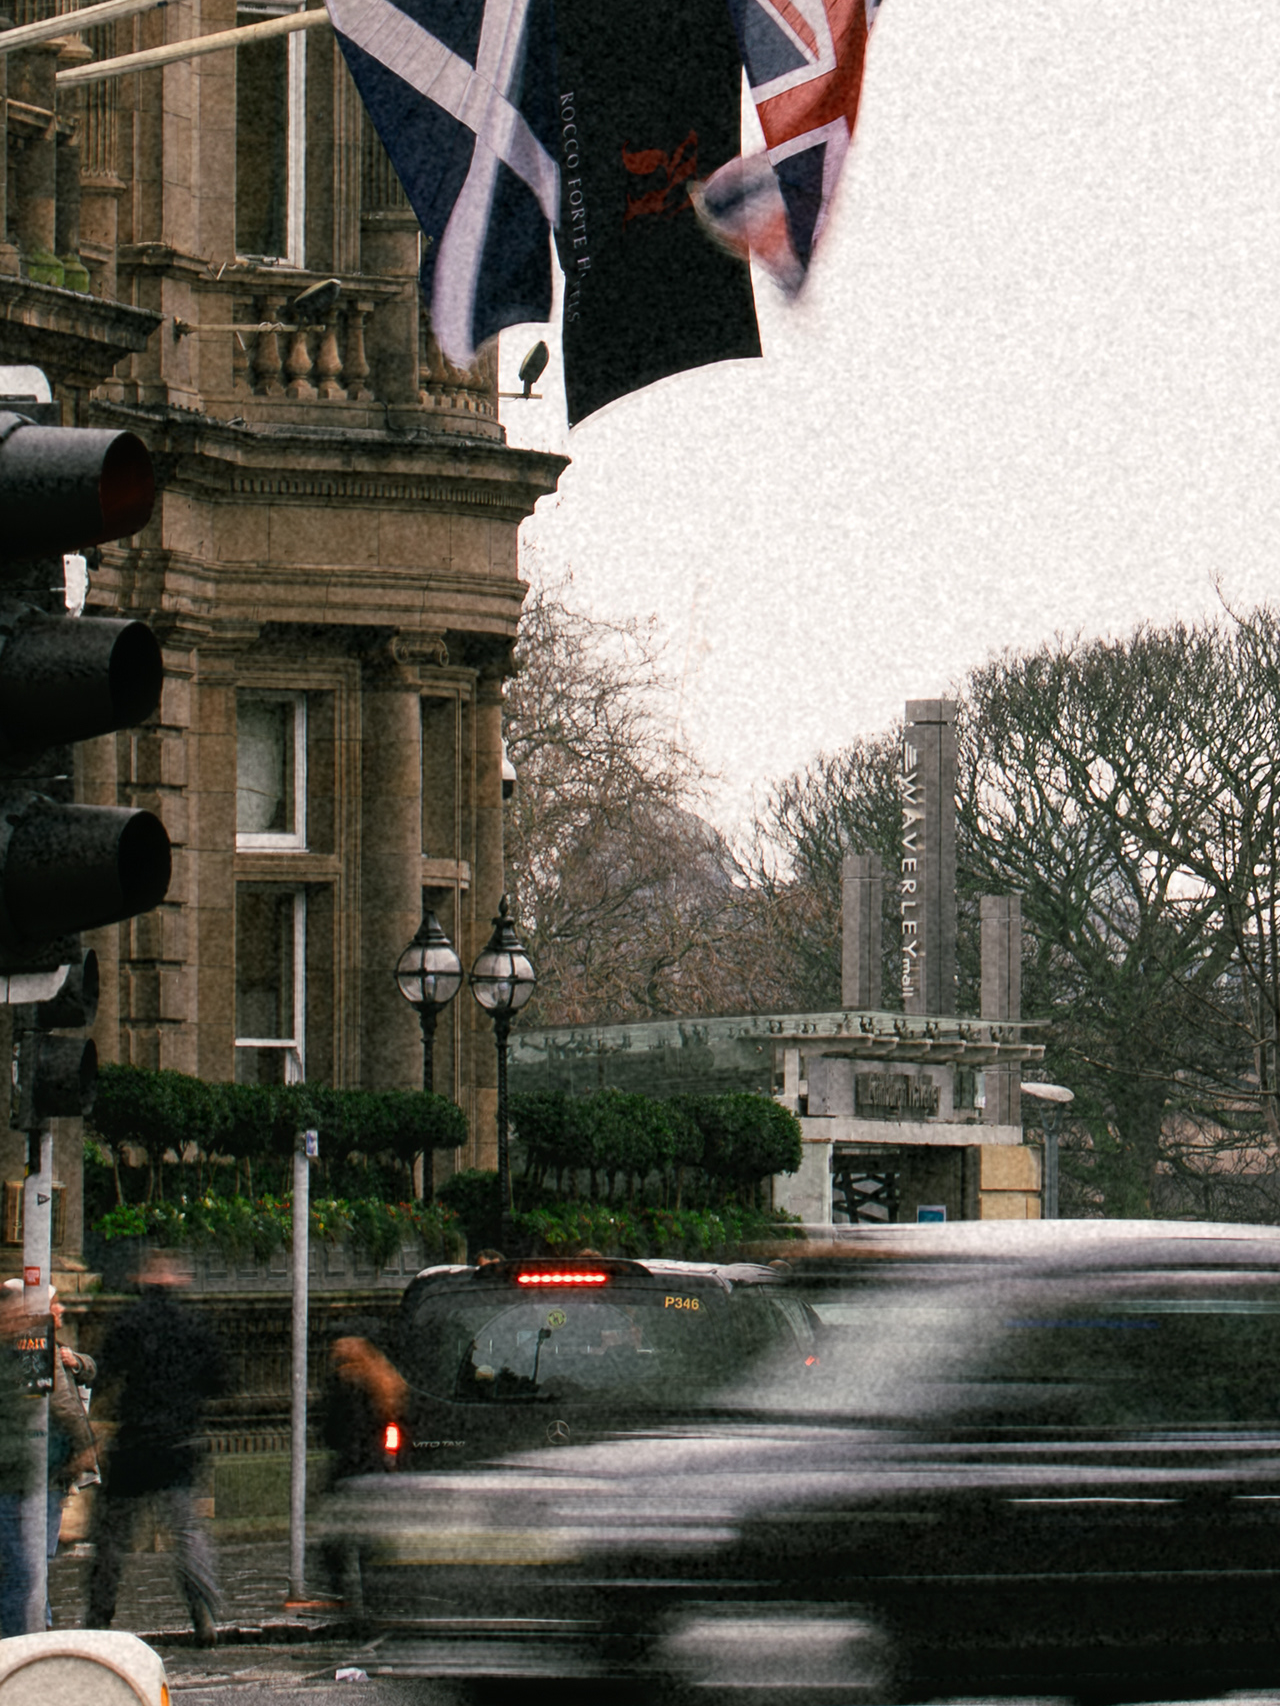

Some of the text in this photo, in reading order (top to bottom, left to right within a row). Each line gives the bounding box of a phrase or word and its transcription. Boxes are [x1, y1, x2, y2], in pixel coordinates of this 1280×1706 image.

[560, 91, 592, 324] ROCCO FORTE HELS
[664, 1295, 700, 1311] P346
[412, 1440, 466, 1449] VITO TAXI
